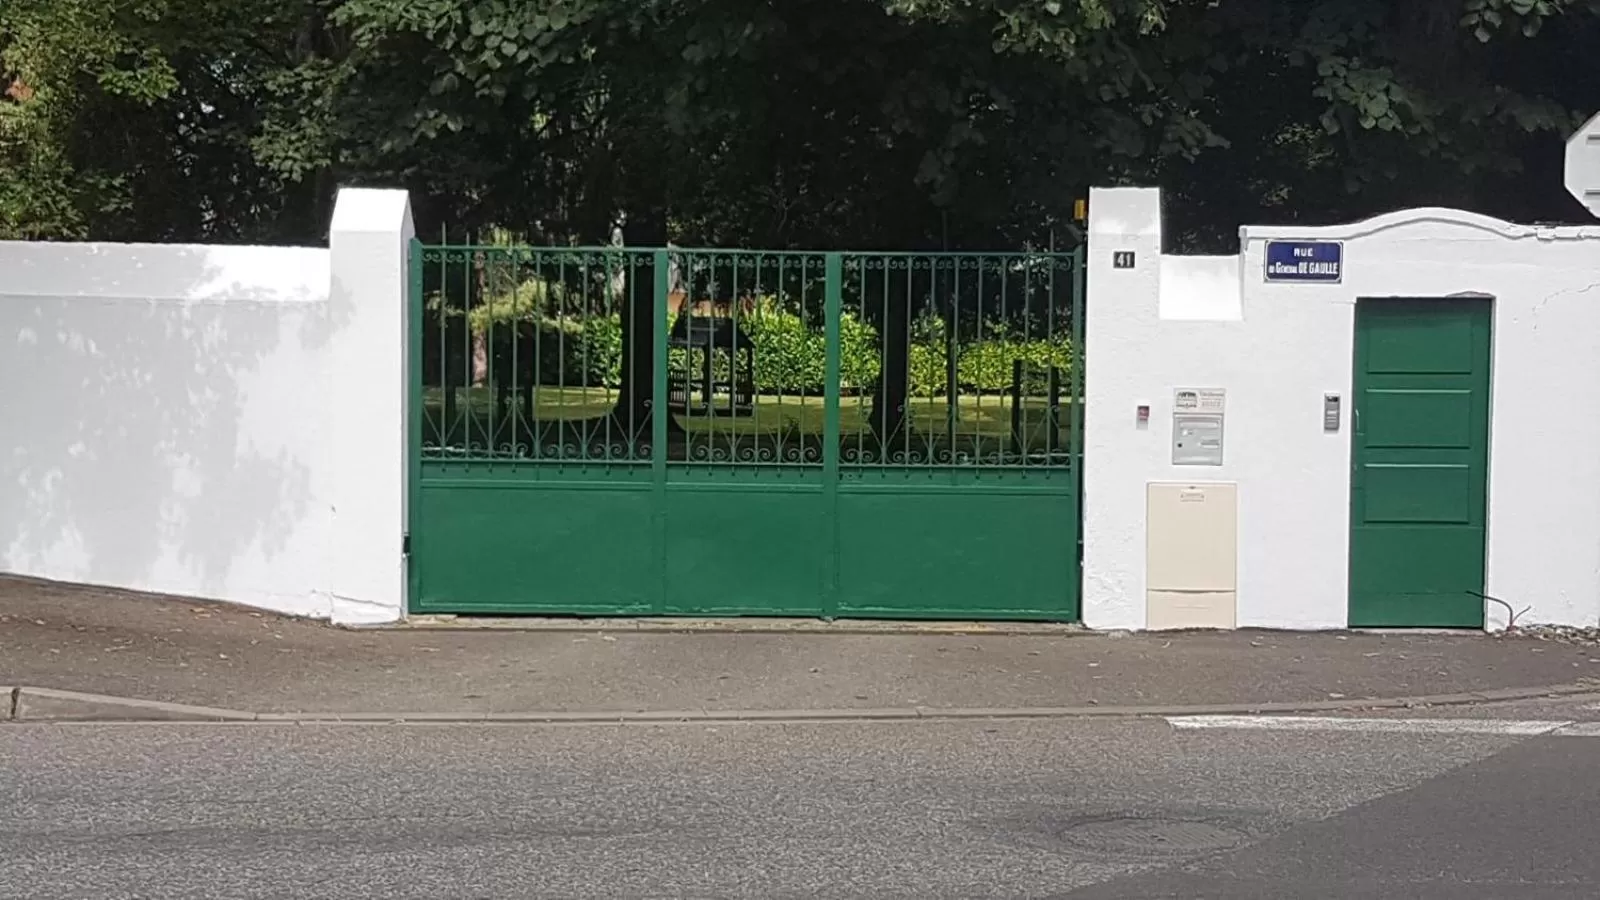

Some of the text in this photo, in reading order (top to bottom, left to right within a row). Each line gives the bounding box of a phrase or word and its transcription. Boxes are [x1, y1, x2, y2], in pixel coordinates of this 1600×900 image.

[1294, 248, 1313, 257] RUE
[1117, 253, 1131, 267] 41
[1299, 261, 1308, 274] DE
[1309, 262, 1338, 274] GAULLE
